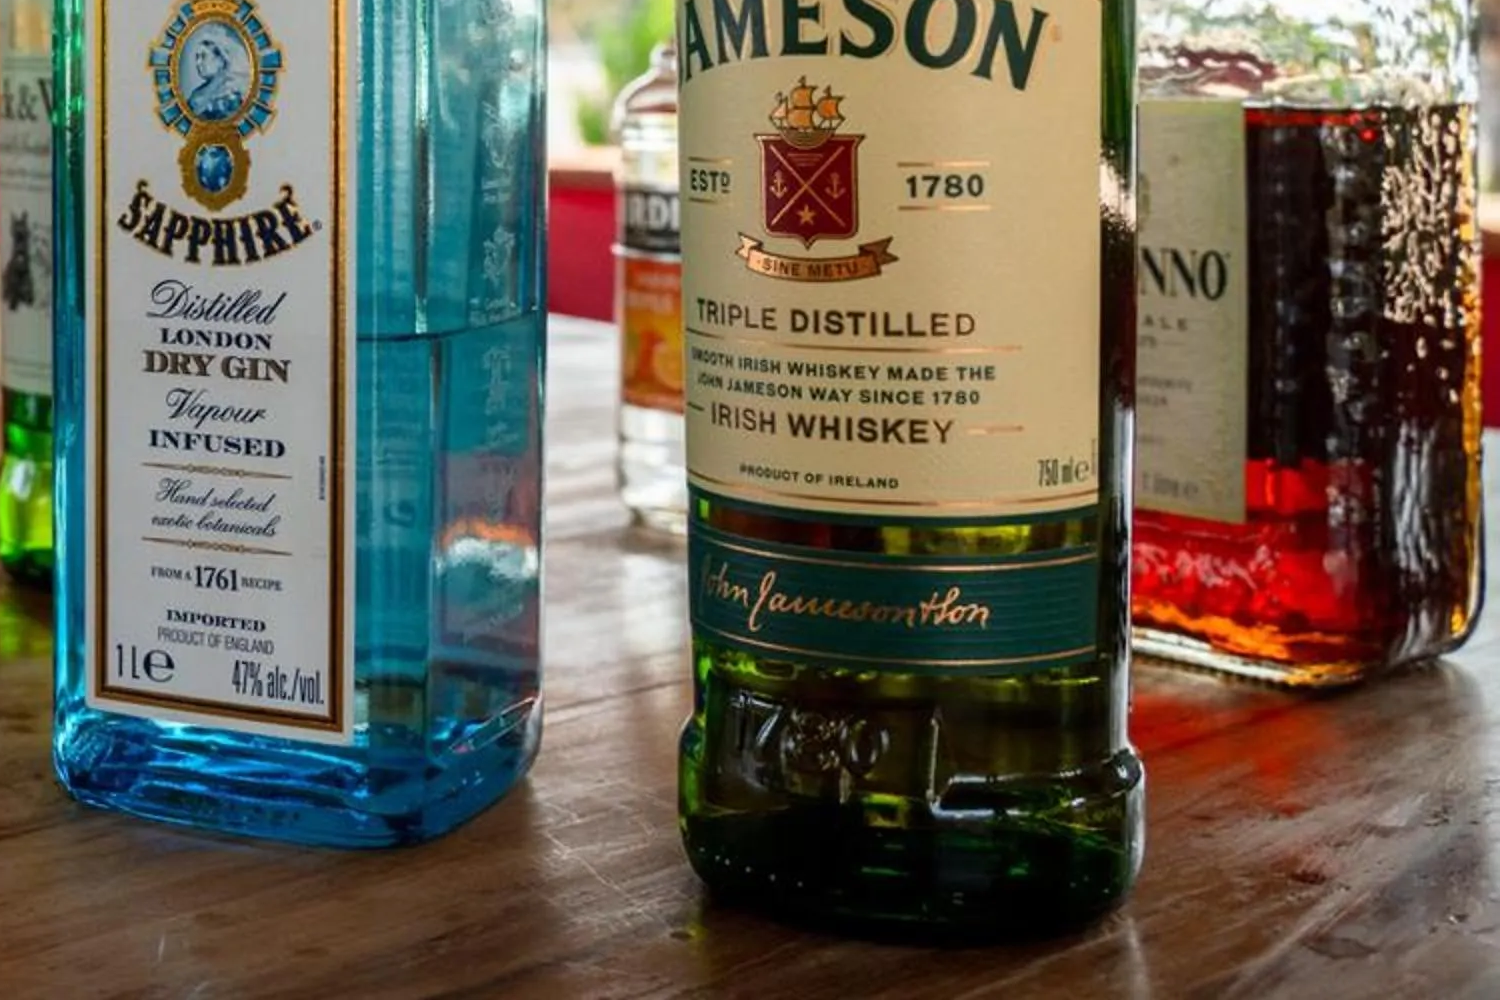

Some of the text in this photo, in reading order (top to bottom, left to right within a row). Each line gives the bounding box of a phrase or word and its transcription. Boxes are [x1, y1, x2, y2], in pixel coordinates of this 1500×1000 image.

[906, 174, 984, 198] 1780
[117, 178, 313, 267] SAPPHIRE
[762, 258, 859, 278] SINE METU
[146, 279, 288, 326] Distilled
[697, 298, 976, 337] TRIPLE DISTILLED
[160, 327, 273, 350] LONDON
[143, 349, 293, 383] DRY GIN
[738, 357, 781, 374] IRISH
[787, 361, 881, 380] WHISKEY
[887, 366, 949, 381] MADE
[956, 366, 996, 381] THE
[727, 380, 802, 399] JAMESON
[808, 386, 853, 403] WAY
[858, 389, 925, 405] SINCE
[932, 391, 980, 405] 1780
[165, 387, 267, 430] Vapour
[711, 402, 954, 445] IRISH WHISKEY
[149, 429, 286, 459] INFUSED
[739, 463, 899, 490] PRODUCT OF IRELAND
[155, 477, 277, 514] Hand selected
[152, 511, 281, 537] exotic botanicals
[151, 566, 183, 580] FROM
[195, 565, 238, 592] 1761
[241, 577, 283, 592] RECIPE
[166, 609, 266, 633] IMPORTED
[157, 626, 275, 656] PRODUCT OF ENGLAND
[232, 660, 263, 697] 47%
